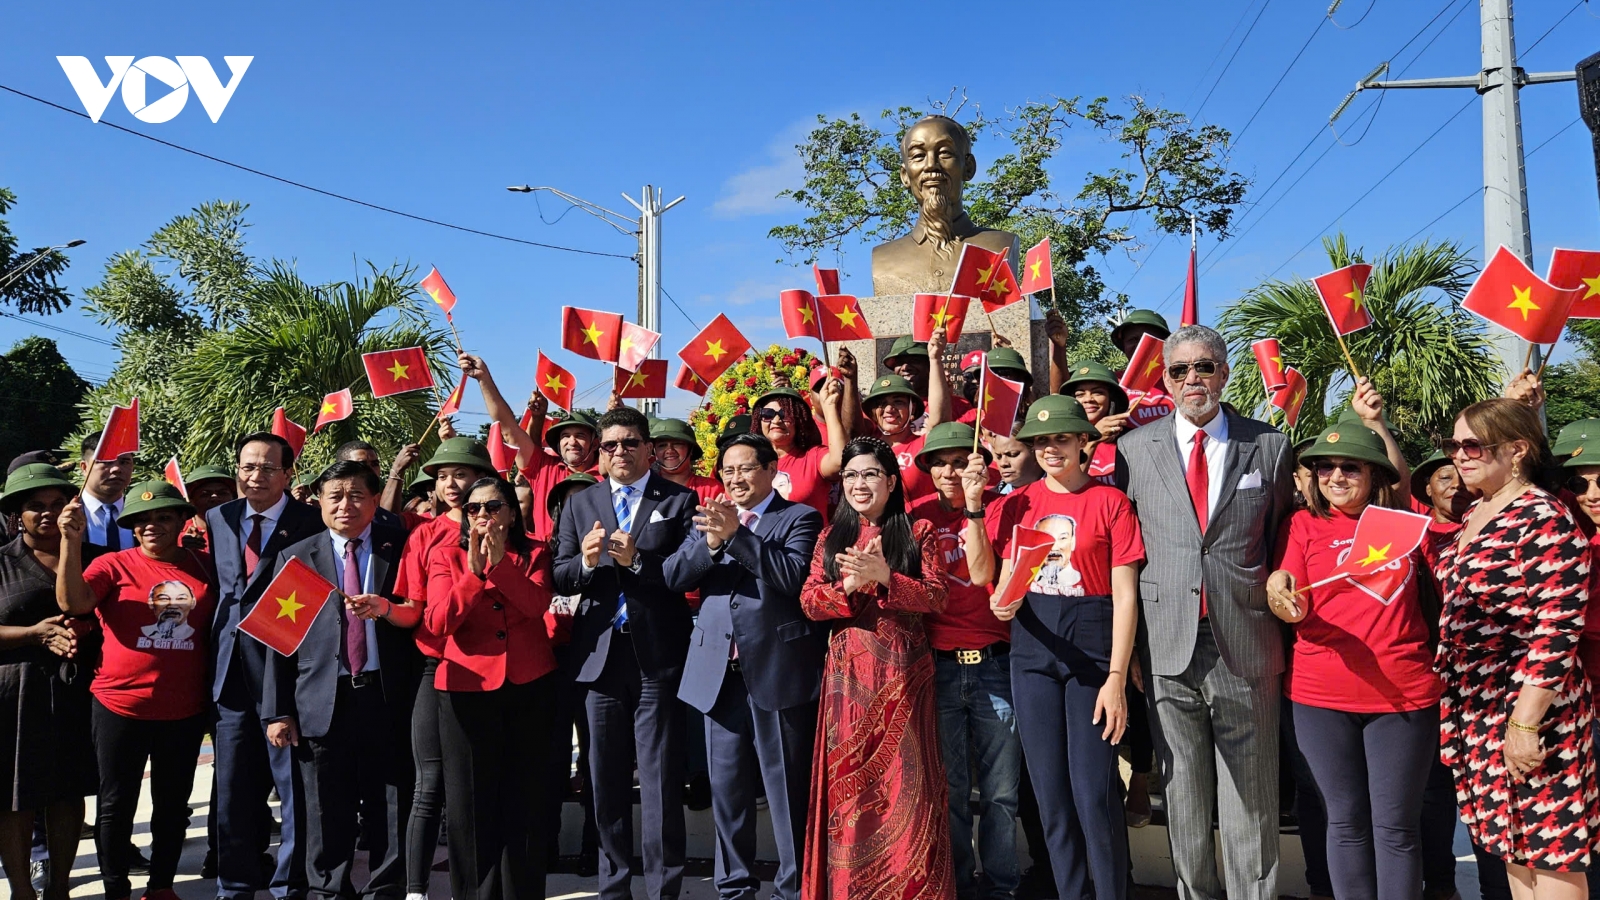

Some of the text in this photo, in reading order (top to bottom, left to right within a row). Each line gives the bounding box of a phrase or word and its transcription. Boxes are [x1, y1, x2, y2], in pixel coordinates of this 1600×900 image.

[1138, 405, 1169, 419] MIU
[1328, 538, 1355, 549] Som
[944, 546, 964, 564] MI
[136, 637, 194, 650] Ho Chi Minh
